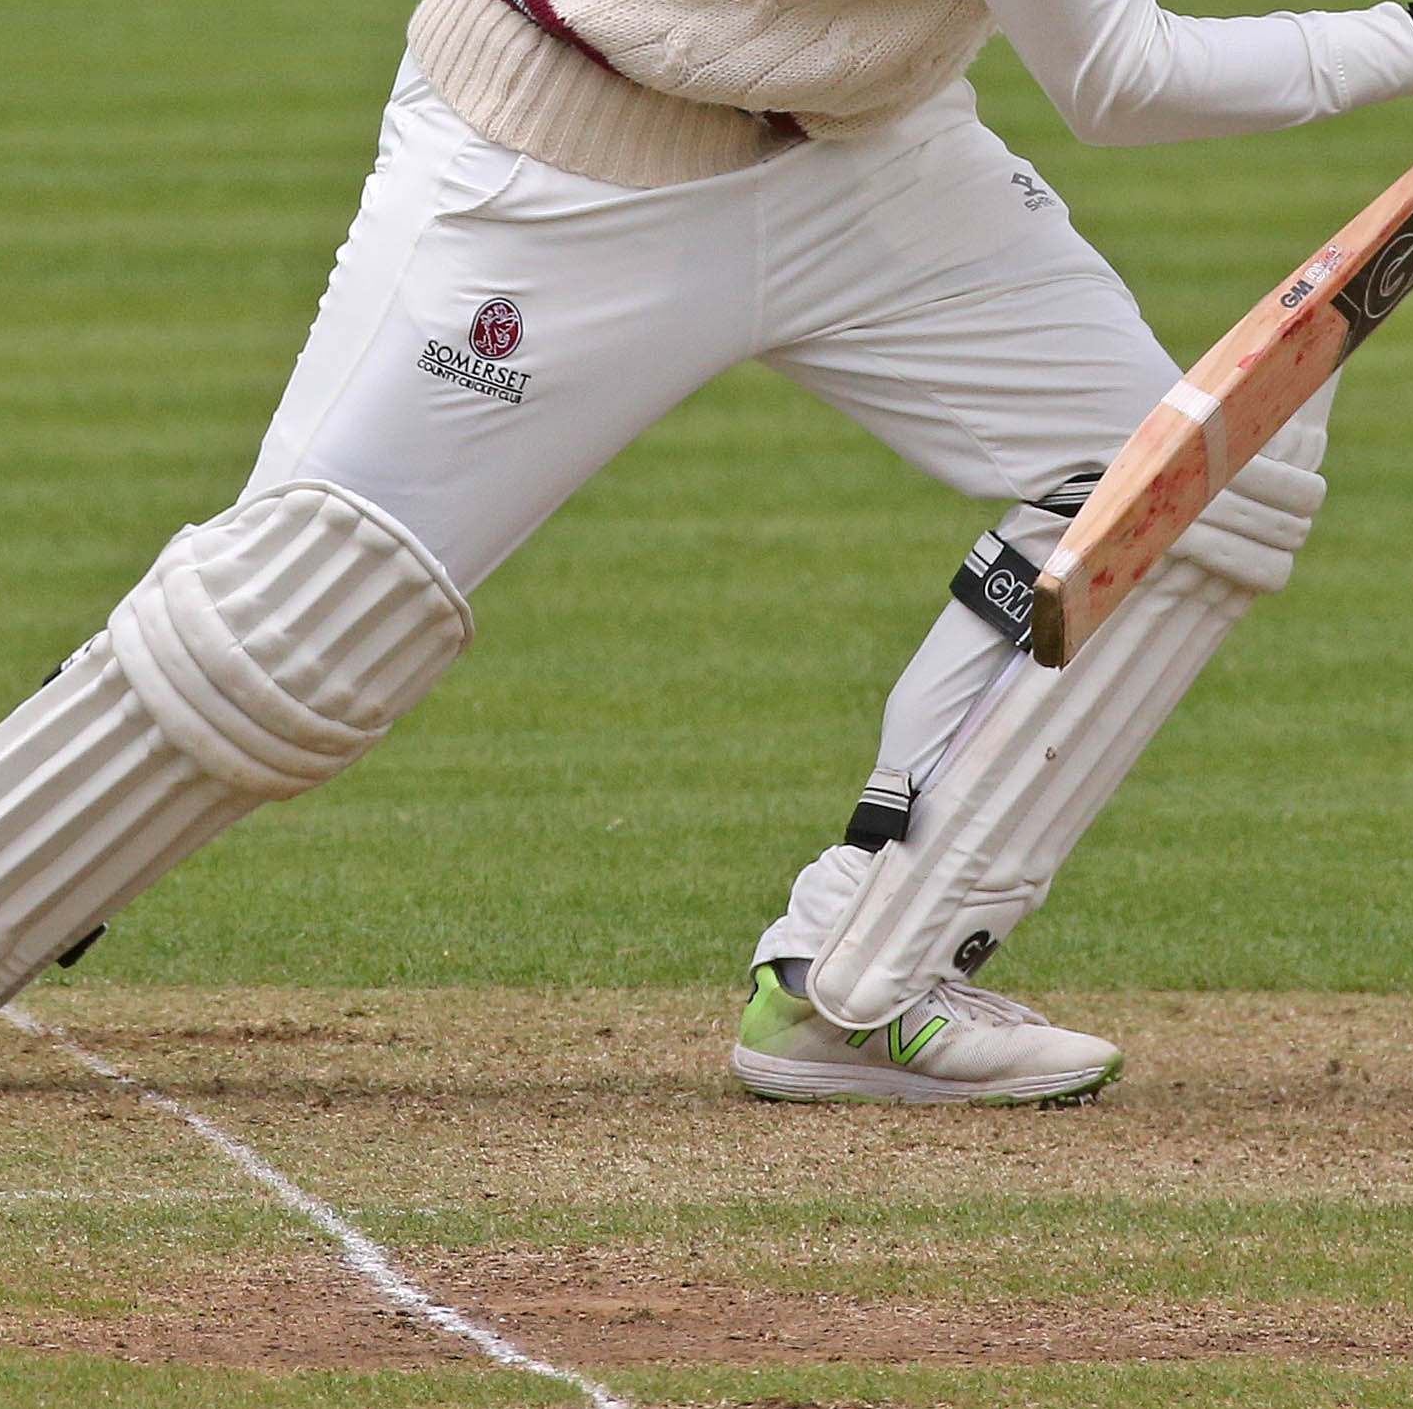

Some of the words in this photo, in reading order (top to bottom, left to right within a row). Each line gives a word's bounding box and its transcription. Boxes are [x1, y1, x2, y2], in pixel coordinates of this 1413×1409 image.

[1280, 279, 1314, 309] GM
[417, 358, 459, 382] COUNTY
[424, 339, 531, 390] SOMERSET
[985, 569, 1035, 623] GM
